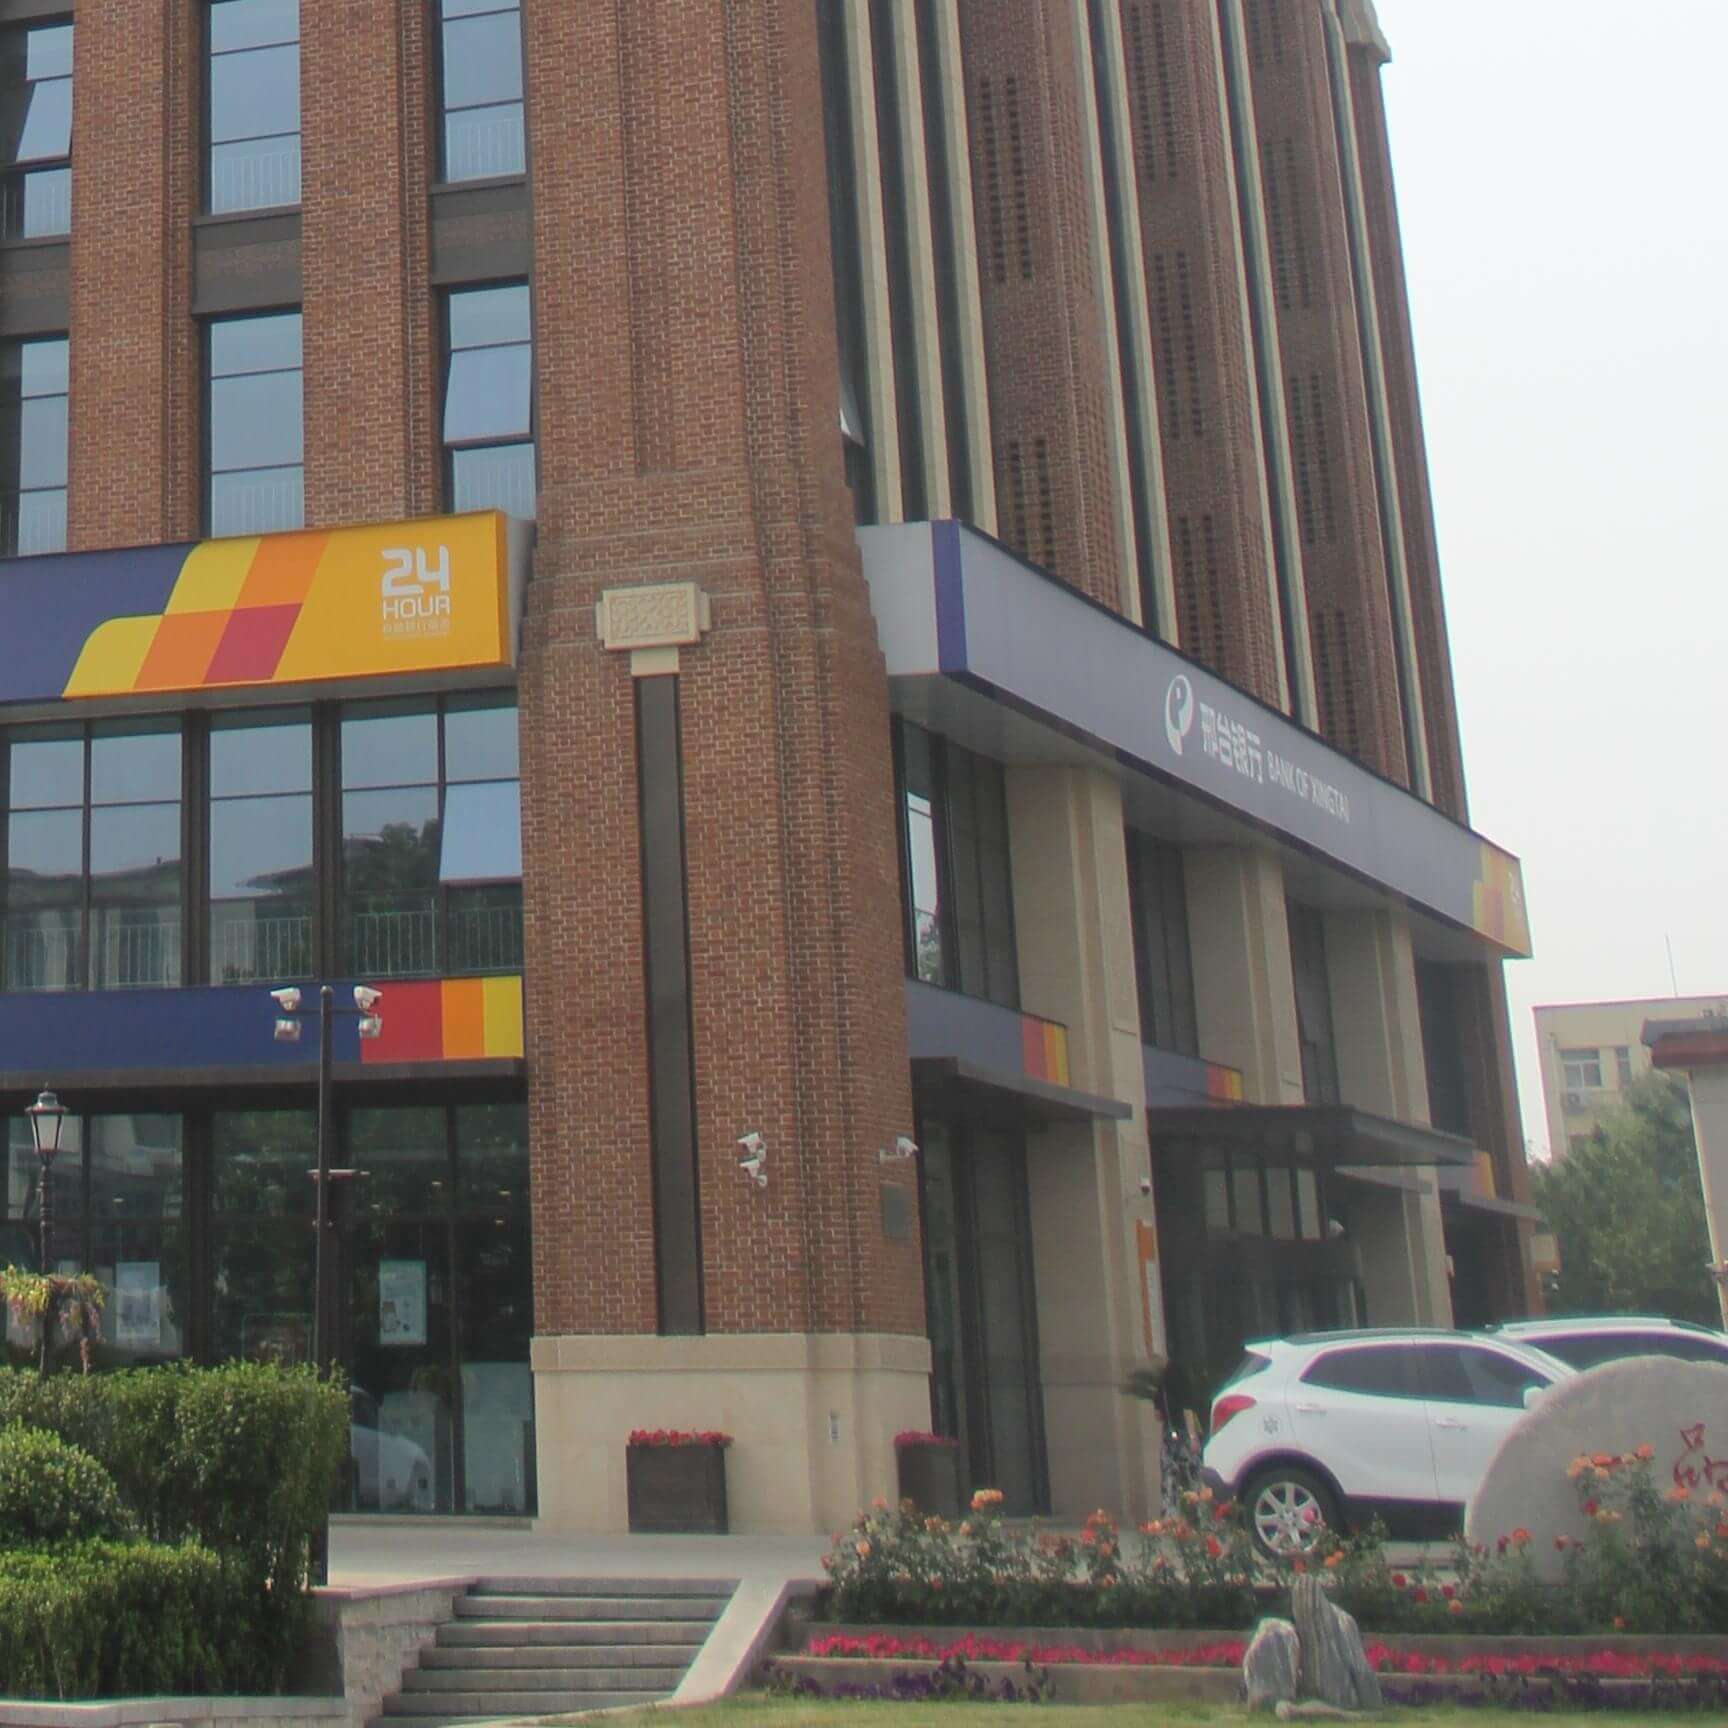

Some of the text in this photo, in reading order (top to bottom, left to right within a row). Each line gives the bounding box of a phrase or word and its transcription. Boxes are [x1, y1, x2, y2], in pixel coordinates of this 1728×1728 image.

[381, 544, 450, 597] 24
[382, 594, 450, 620] HOUR
[1199, 701, 1263, 784] 邢台银行
[1267, 749, 1296, 794] BANK
